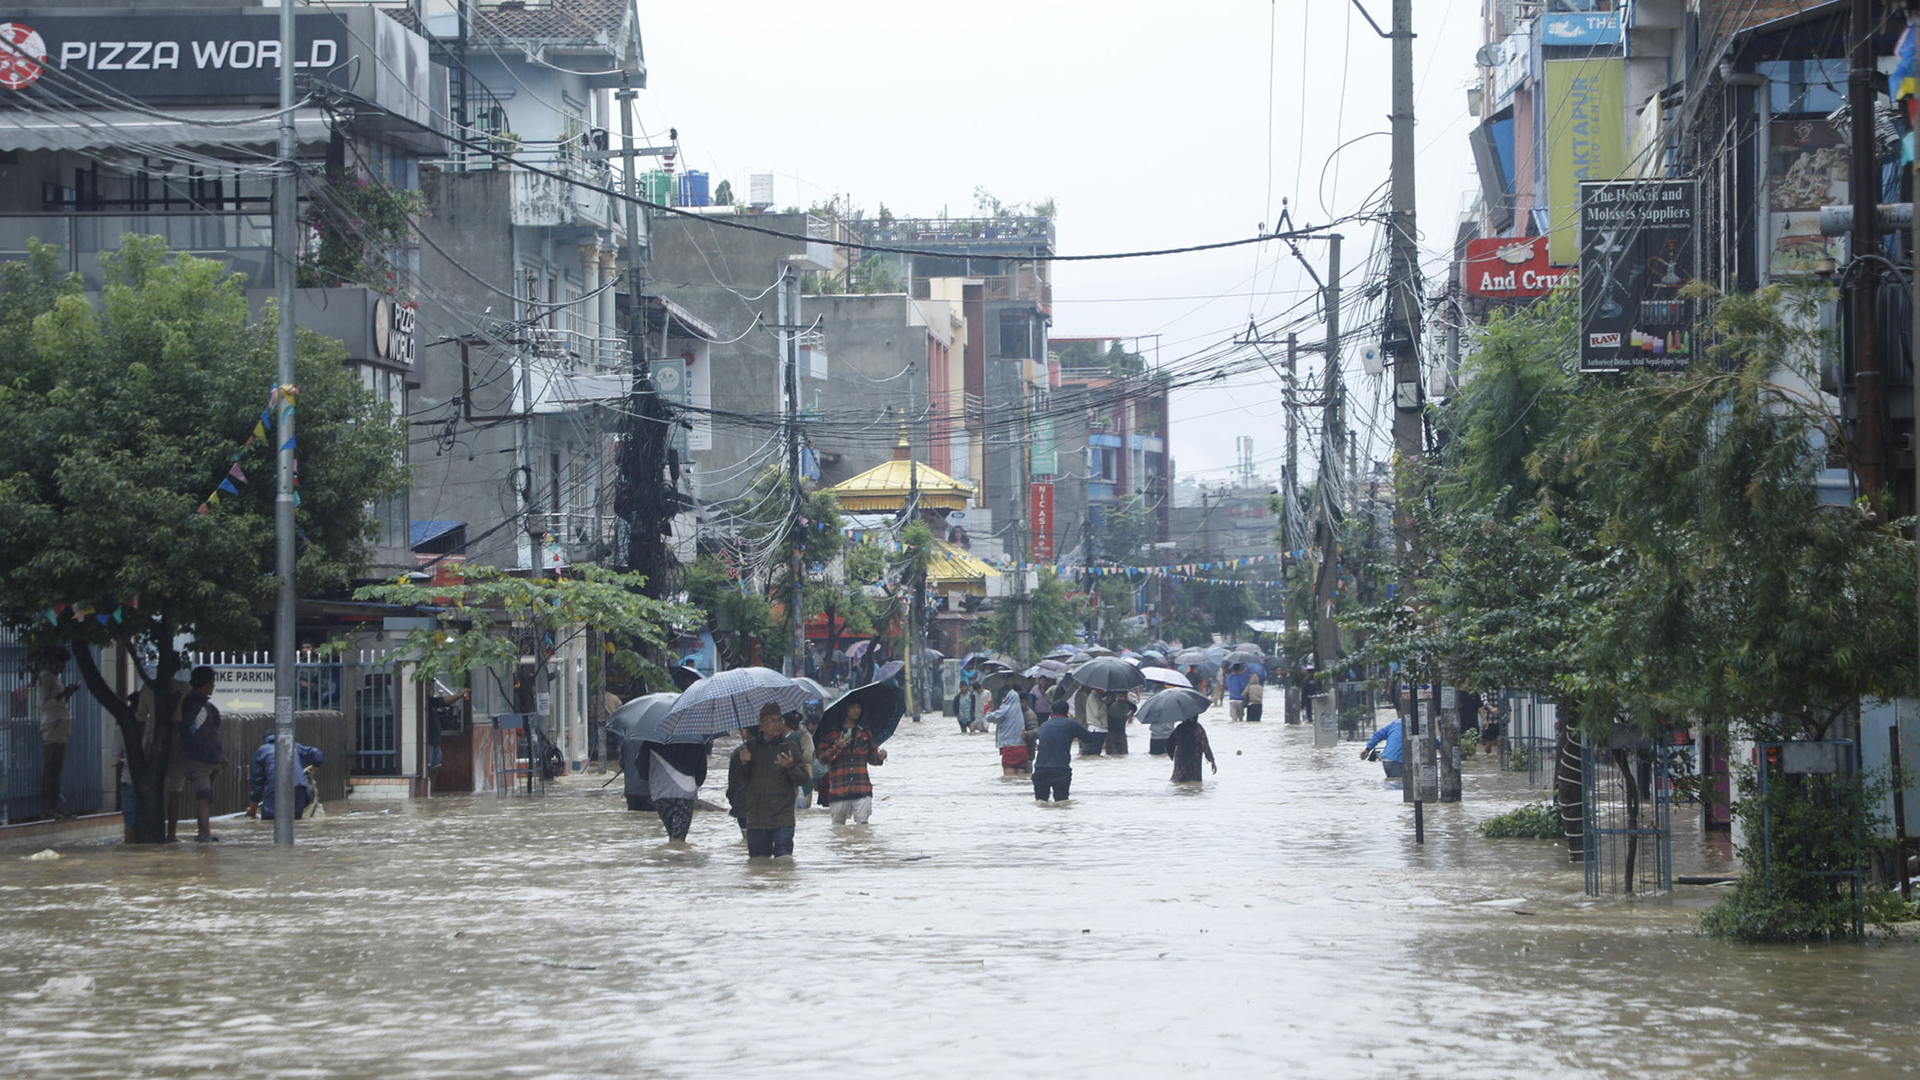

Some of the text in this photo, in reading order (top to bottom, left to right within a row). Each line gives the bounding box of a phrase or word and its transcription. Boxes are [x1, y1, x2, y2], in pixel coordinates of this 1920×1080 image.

[1586, 17, 1617, 29] THE
[60, 41, 179, 70] PIZZA
[1592, 188, 1616, 203] The
[1662, 187, 1682, 200] and
[1480, 270, 1517, 291] And
[389, 331, 415, 365] WORLD
[1591, 334, 1619, 345] RAW
[1038, 486, 1046, 508] NIC
[215, 671, 276, 682] IKE PARKIN
